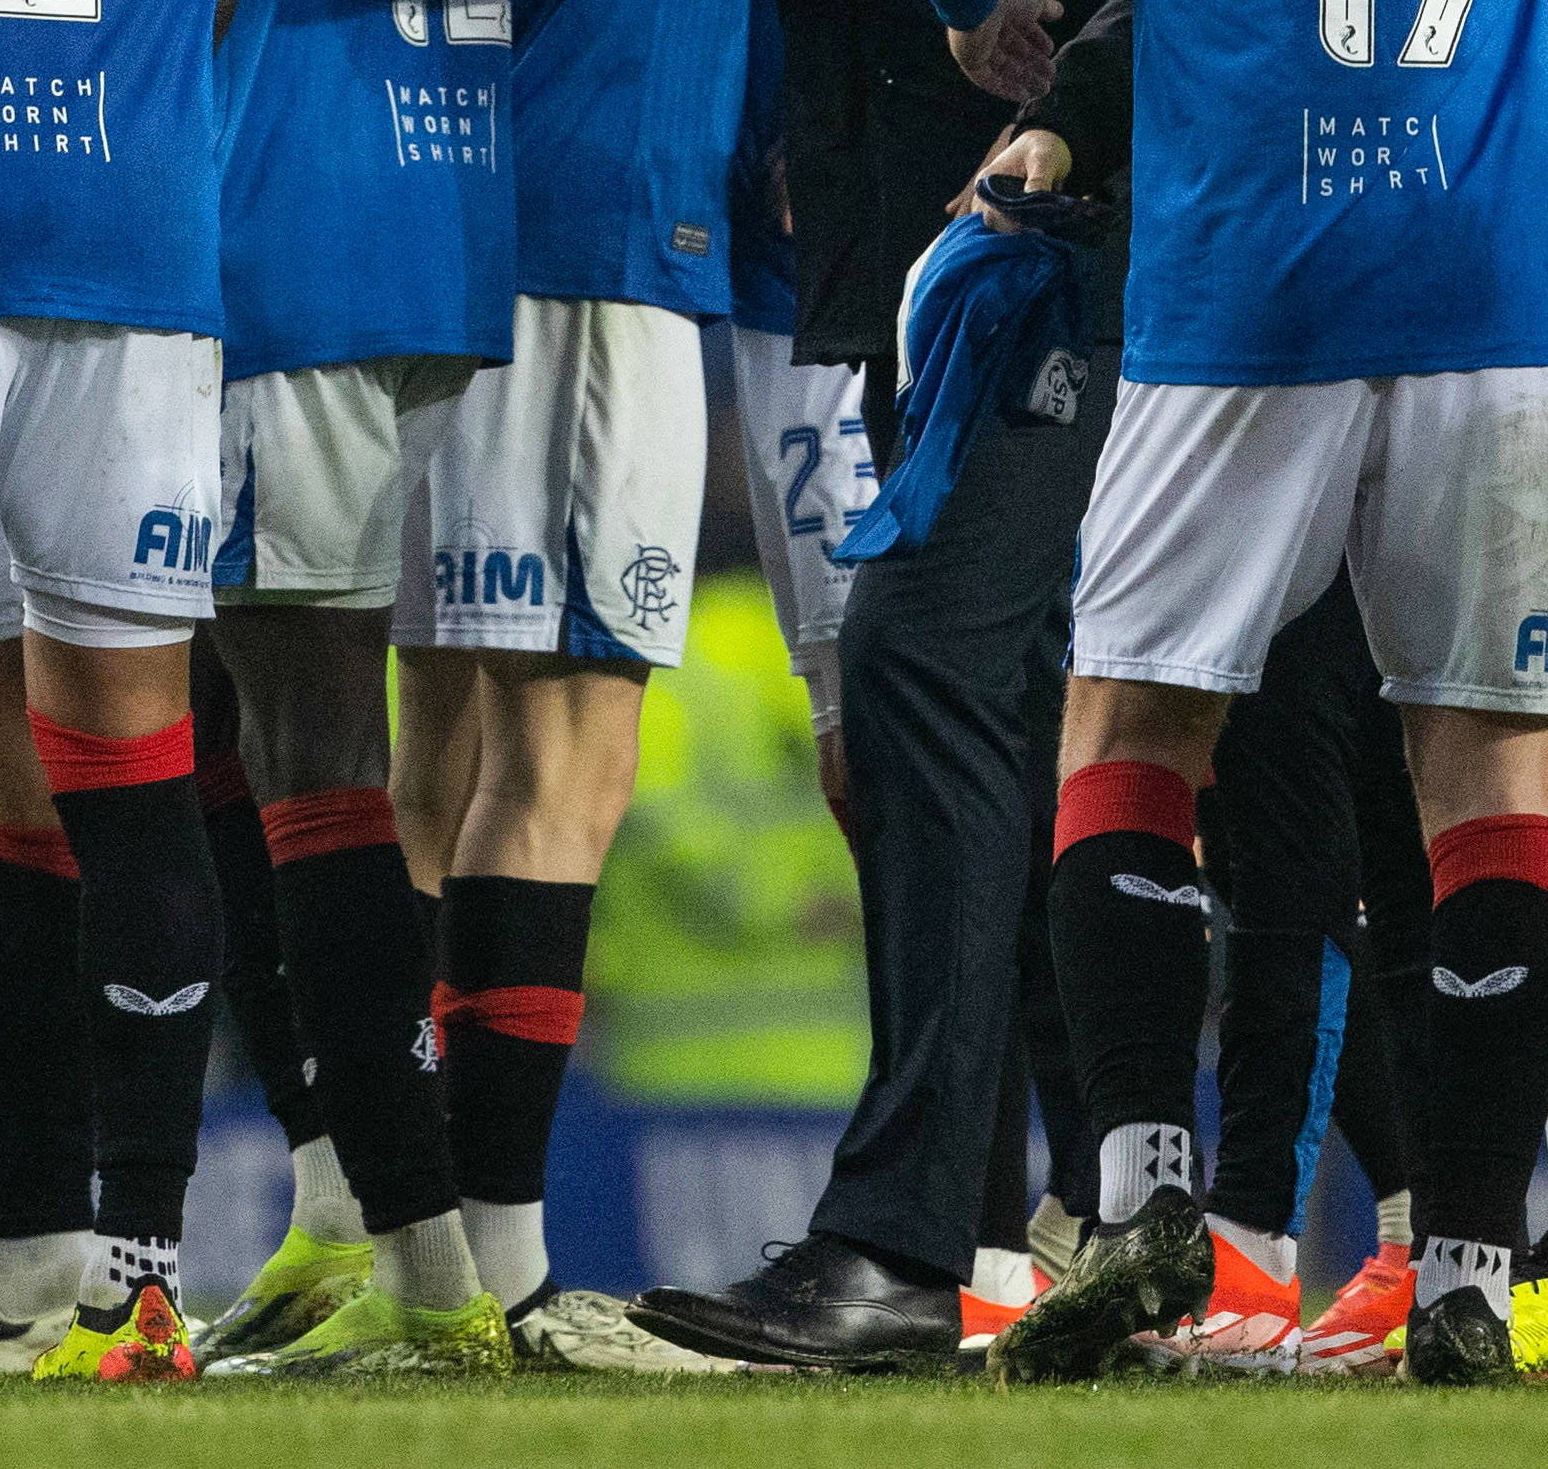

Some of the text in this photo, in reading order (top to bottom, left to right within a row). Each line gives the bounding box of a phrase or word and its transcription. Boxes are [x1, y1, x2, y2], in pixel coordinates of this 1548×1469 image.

[399, 87, 489, 107] MATCH
[401, 114, 471, 136] WORN
[1319, 116, 1420, 137] MATC
[408, 142, 488, 165] SHIRT
[1317, 146, 1408, 167] WOR
[1319, 167, 1429, 198] SHRT
